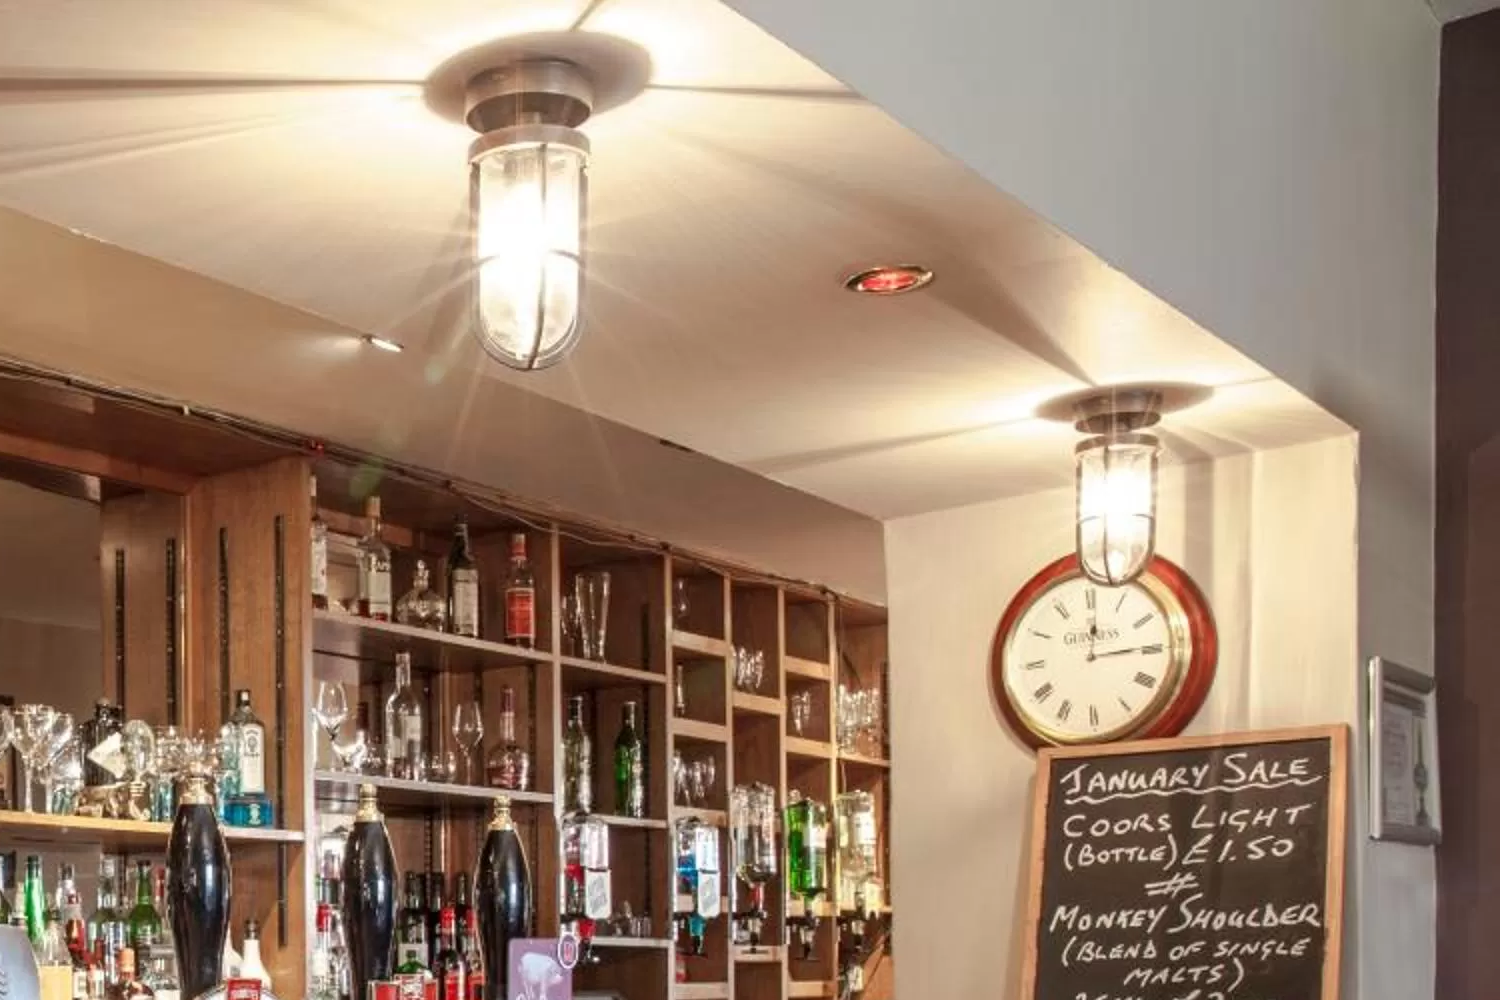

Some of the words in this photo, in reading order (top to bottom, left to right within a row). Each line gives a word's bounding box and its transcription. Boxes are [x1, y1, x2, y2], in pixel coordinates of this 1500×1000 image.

[1060, 764, 1209, 796] JANUARY
[1223, 752, 1310, 784] SALE
[1063, 813, 1173, 837] COORS
[1191, 804, 1315, 832] LIGHT
[1064, 833, 1178, 871] (BOTTLE)
[1050, 903, 1169, 934] MONKEY
[1166, 893, 1323, 934] SHOULDER
[1061, 936, 1157, 967] (BLEND
[1169, 942, 1208, 961] OF
[1213, 937, 1312, 961] SINGLE
[1123, 957, 1245, 993] MALTS)
